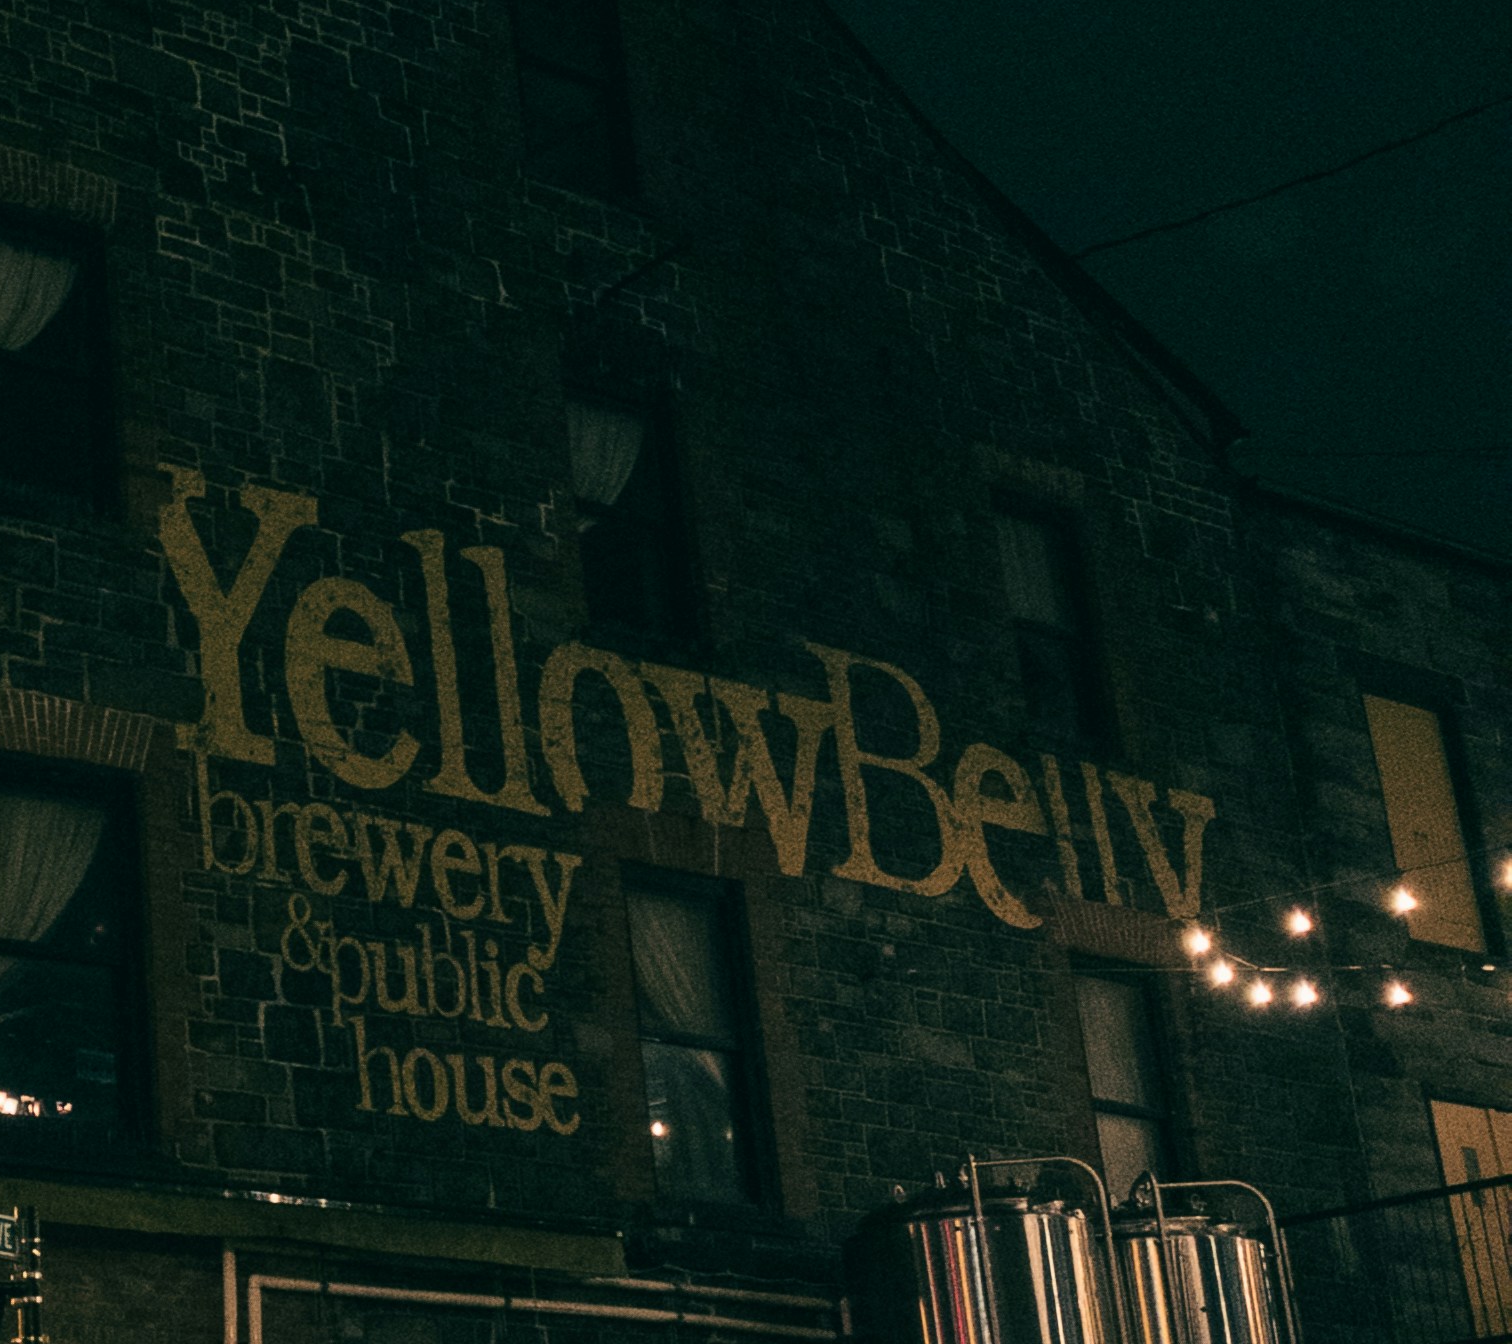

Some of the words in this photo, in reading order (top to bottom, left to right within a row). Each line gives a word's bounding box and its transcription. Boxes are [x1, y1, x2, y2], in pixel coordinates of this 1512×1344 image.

[157, 461, 1216, 930] YellowBelly
[195, 753, 583, 970] brewery
[314, 920, 550, 1033] public
[348, 1013, 582, 1136] house
